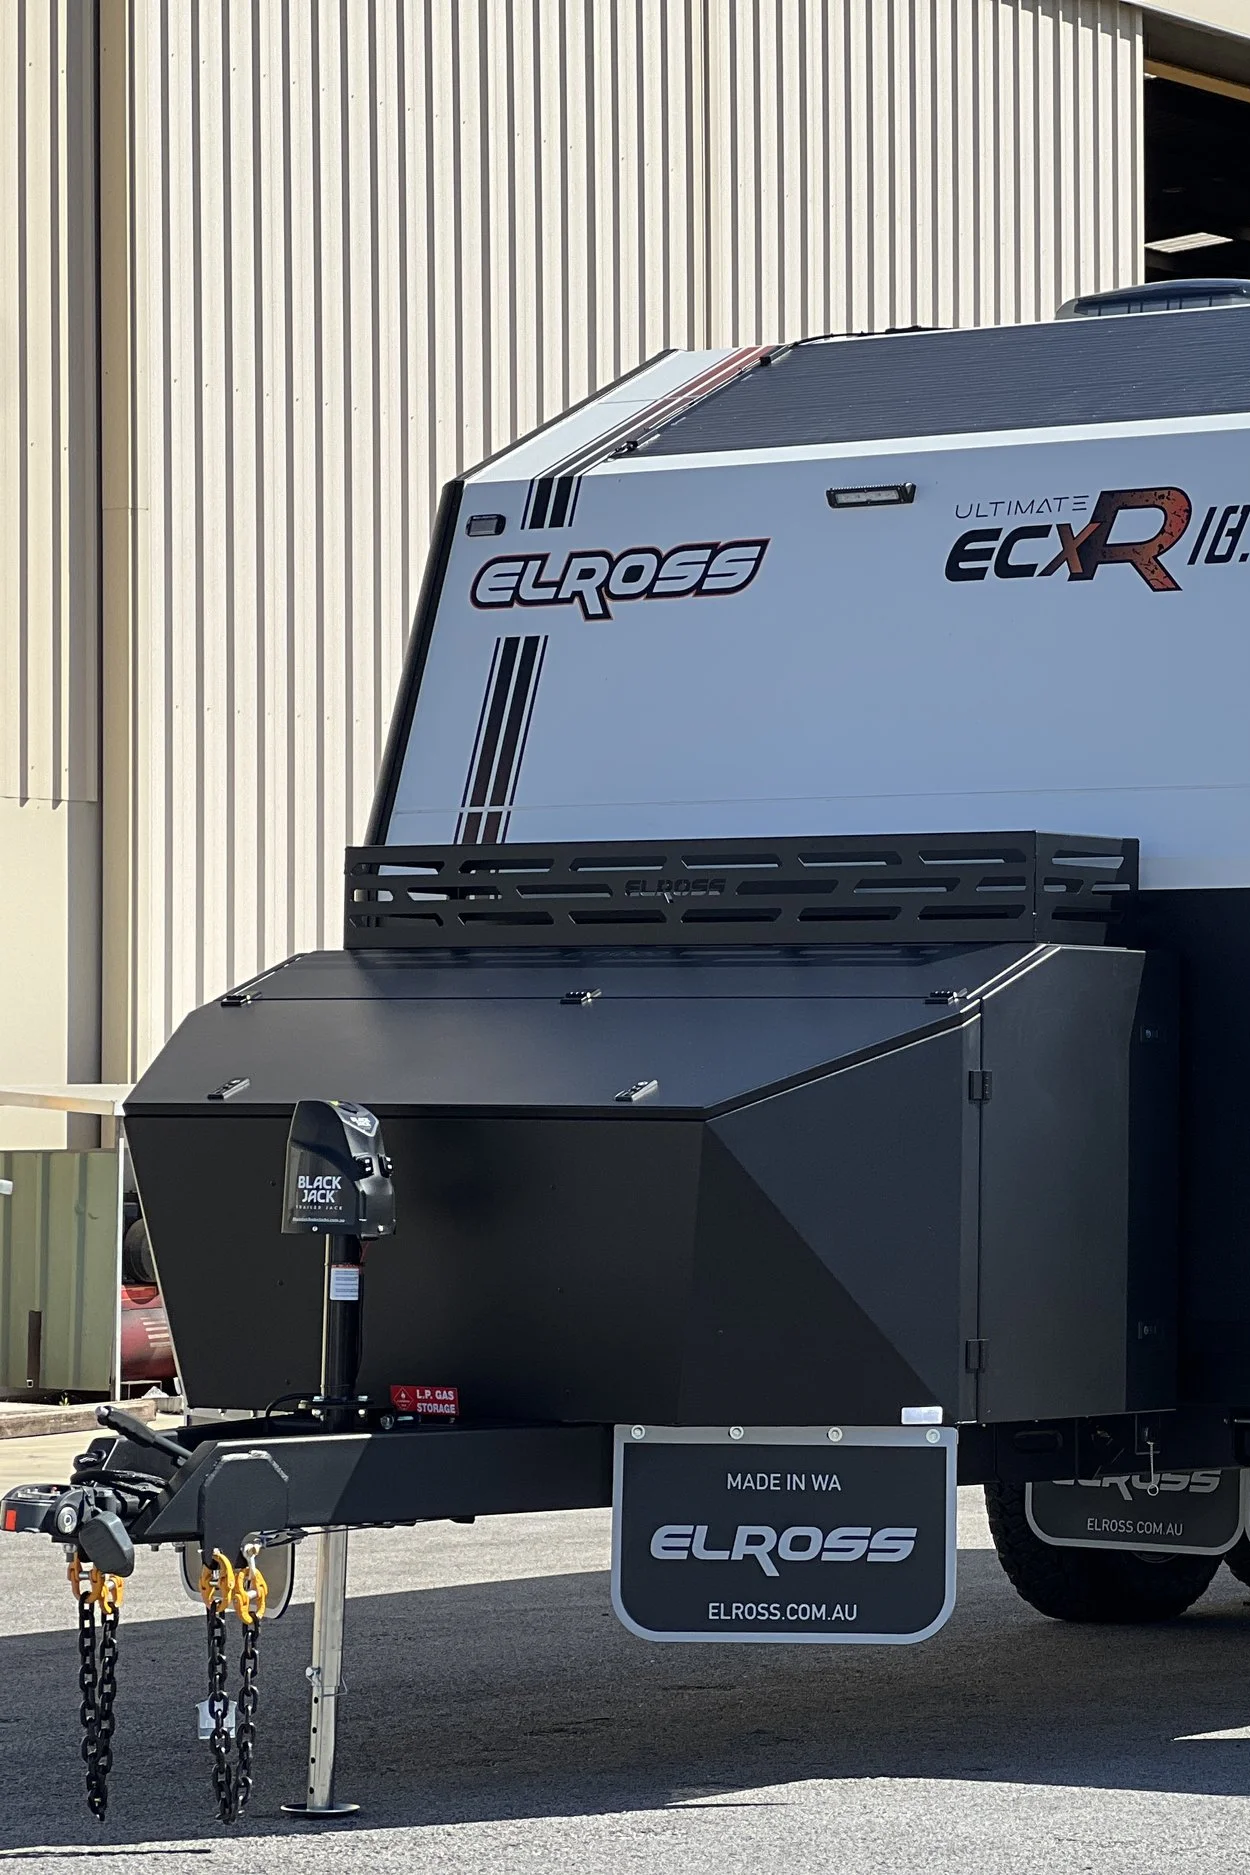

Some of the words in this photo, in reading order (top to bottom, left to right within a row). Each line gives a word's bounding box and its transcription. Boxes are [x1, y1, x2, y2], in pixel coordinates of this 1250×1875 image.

[955, 495, 1090, 519] ULTIMATE
[470, 538, 771, 622] ELROSS
[624, 879, 727, 904] ELROSS
[297, 1175, 342, 1190] BLACK
[301, 1189, 336, 1203] JACK
[416, 1389, 433, 1400] L.P.
[435, 1390, 455, 1401] GAS
[416, 1402, 456, 1414] STORAGE
[726, 1473, 781, 1491] MADE
[786, 1473, 806, 1491] IN
[811, 1474, 842, 1492] WA
[1086, 1517, 1184, 1537] ELROSS.COM.AU
[650, 1524, 918, 1577] ELROSS
[708, 1602, 858, 1621] ELROSS.COM.AU
